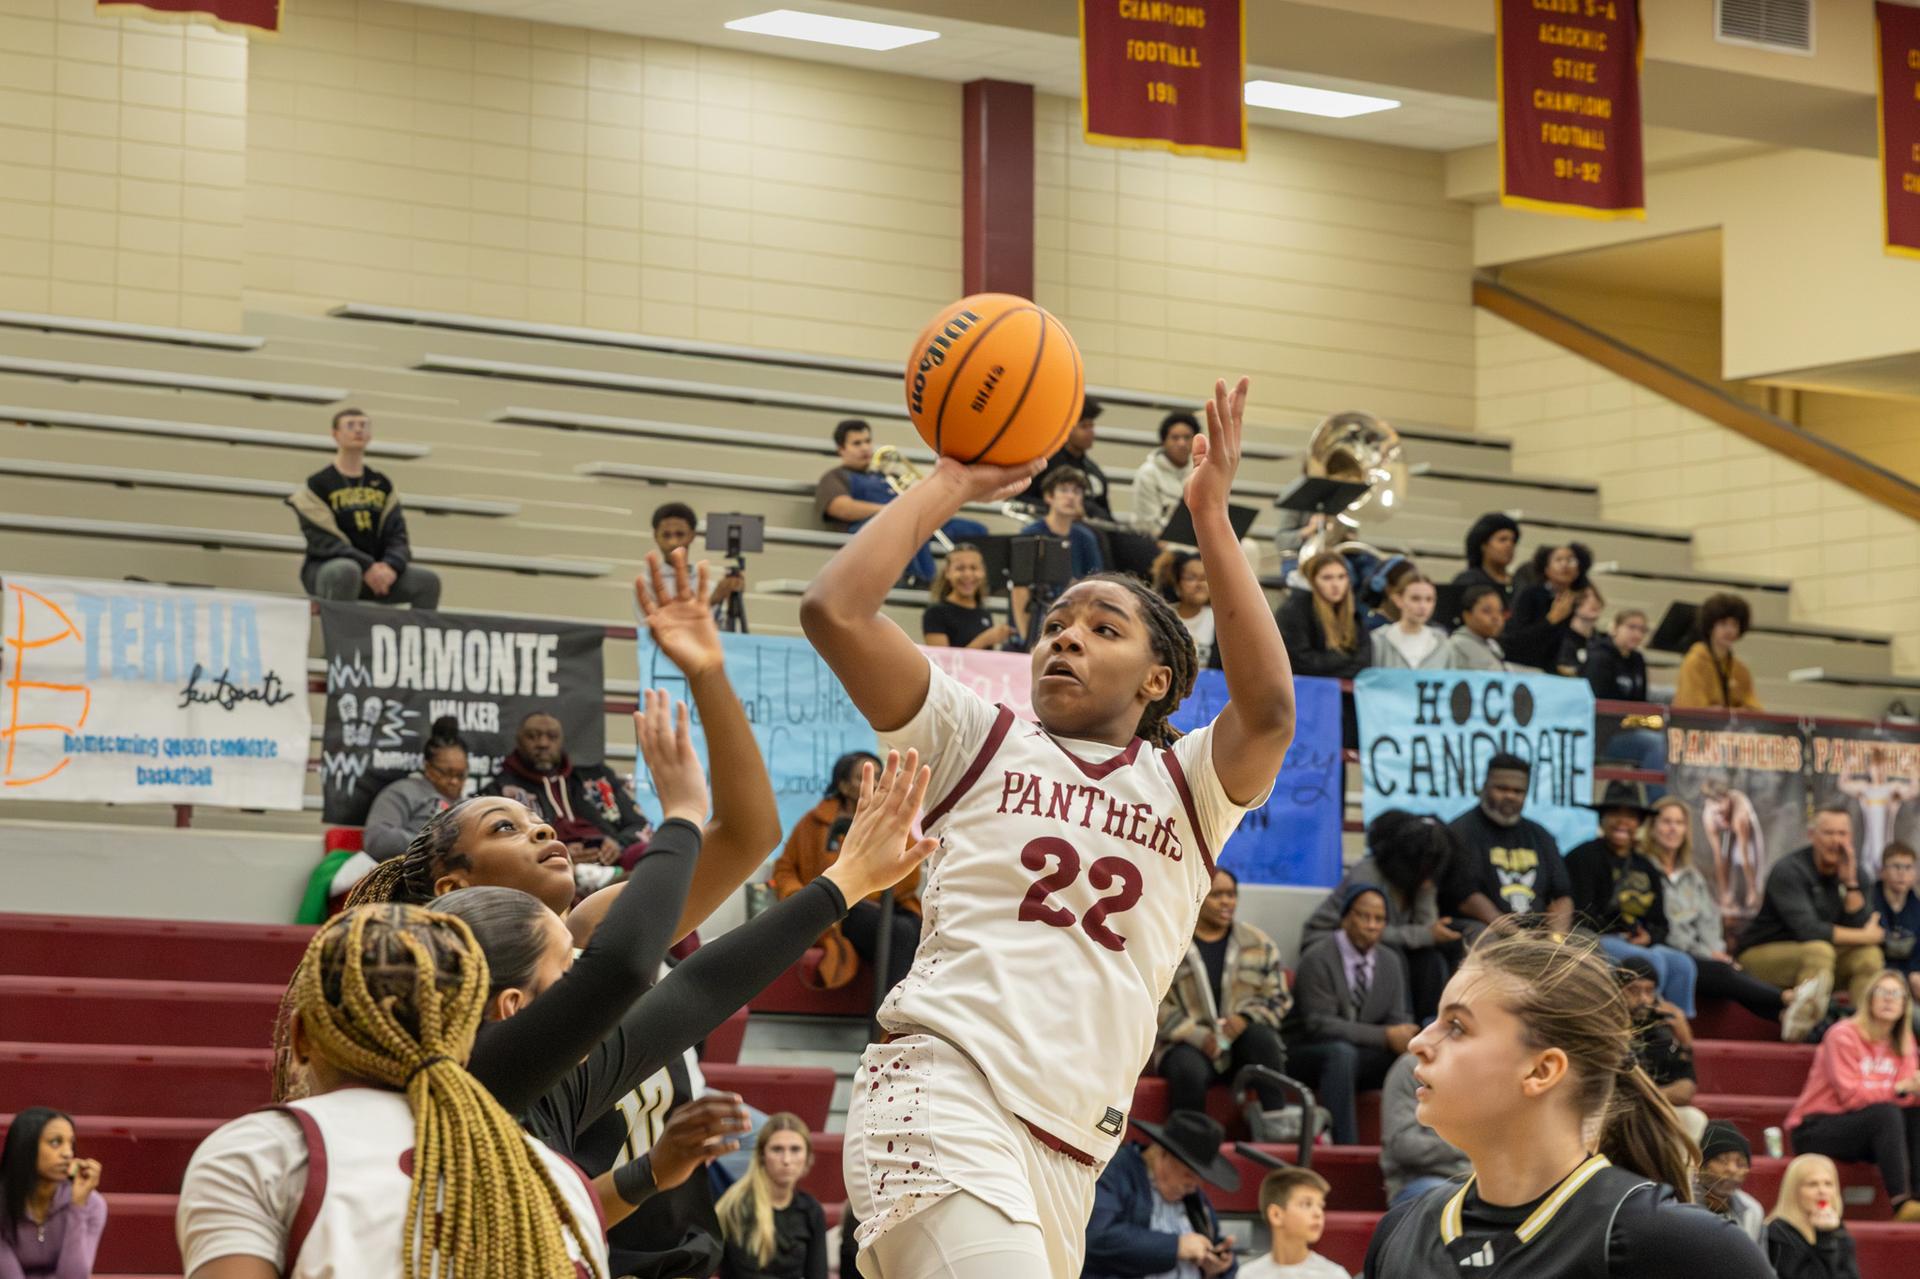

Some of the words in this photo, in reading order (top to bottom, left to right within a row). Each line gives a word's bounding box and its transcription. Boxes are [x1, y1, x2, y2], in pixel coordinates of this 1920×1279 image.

[1127, 39, 1201, 68] FOOTALL
[911, 310, 980, 414] Wilson
[371, 624, 560, 697] DAMONTE
[429, 699, 500, 734] WALKER
[1414, 680, 1535, 727] HOCO
[1667, 727, 1803, 772] PANTHERS
[1018, 835, 1144, 952] 22
